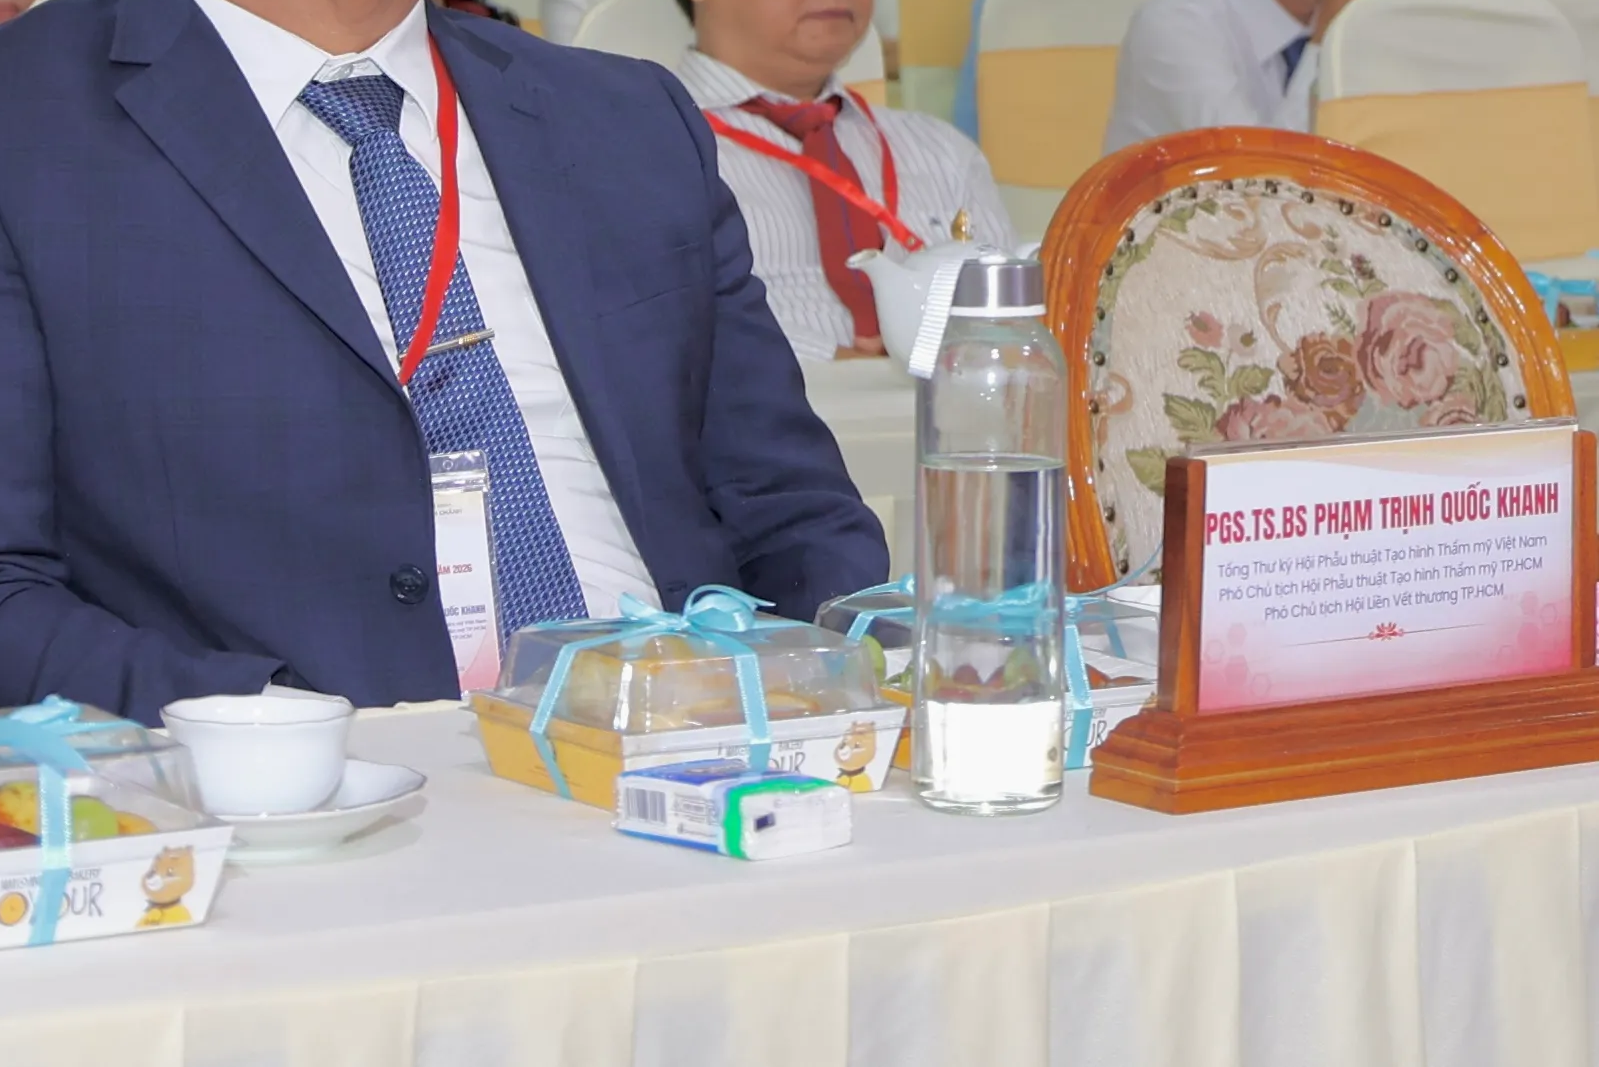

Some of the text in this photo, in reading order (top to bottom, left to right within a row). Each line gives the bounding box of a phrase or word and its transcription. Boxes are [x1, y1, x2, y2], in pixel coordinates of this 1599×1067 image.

[1205, 481, 1559, 545] PGS.TS.BS PHẠM TRỊNH QUỐC KHANH
[1253, 560, 1277, 574] Thư
[1279, 558, 1293, 575] ký
[1295, 556, 1315, 570] Hội
[1385, 548, 1406, 561] Tạo
[1408, 544, 1435, 559] hình
[1494, 536, 1516, 551] Việt
[1518, 535, 1547, 548] Nam
[1219, 586, 1243, 602] Phó
[1275, 582, 1298, 597] tịch
[1301, 579, 1321, 593] Hội
[1391, 571, 1411, 585] Tạo
[1414, 567, 1440, 582] hình
[1500, 557, 1543, 572] TP.HCM
[1265, 606, 1288, 620] Phó
[1319, 601, 1342, 615] tịch
[1345, 598, 1364, 614] Hội
[1415, 588, 1458, 605] thương
[1460, 584, 1504, 599] TP.HCM
